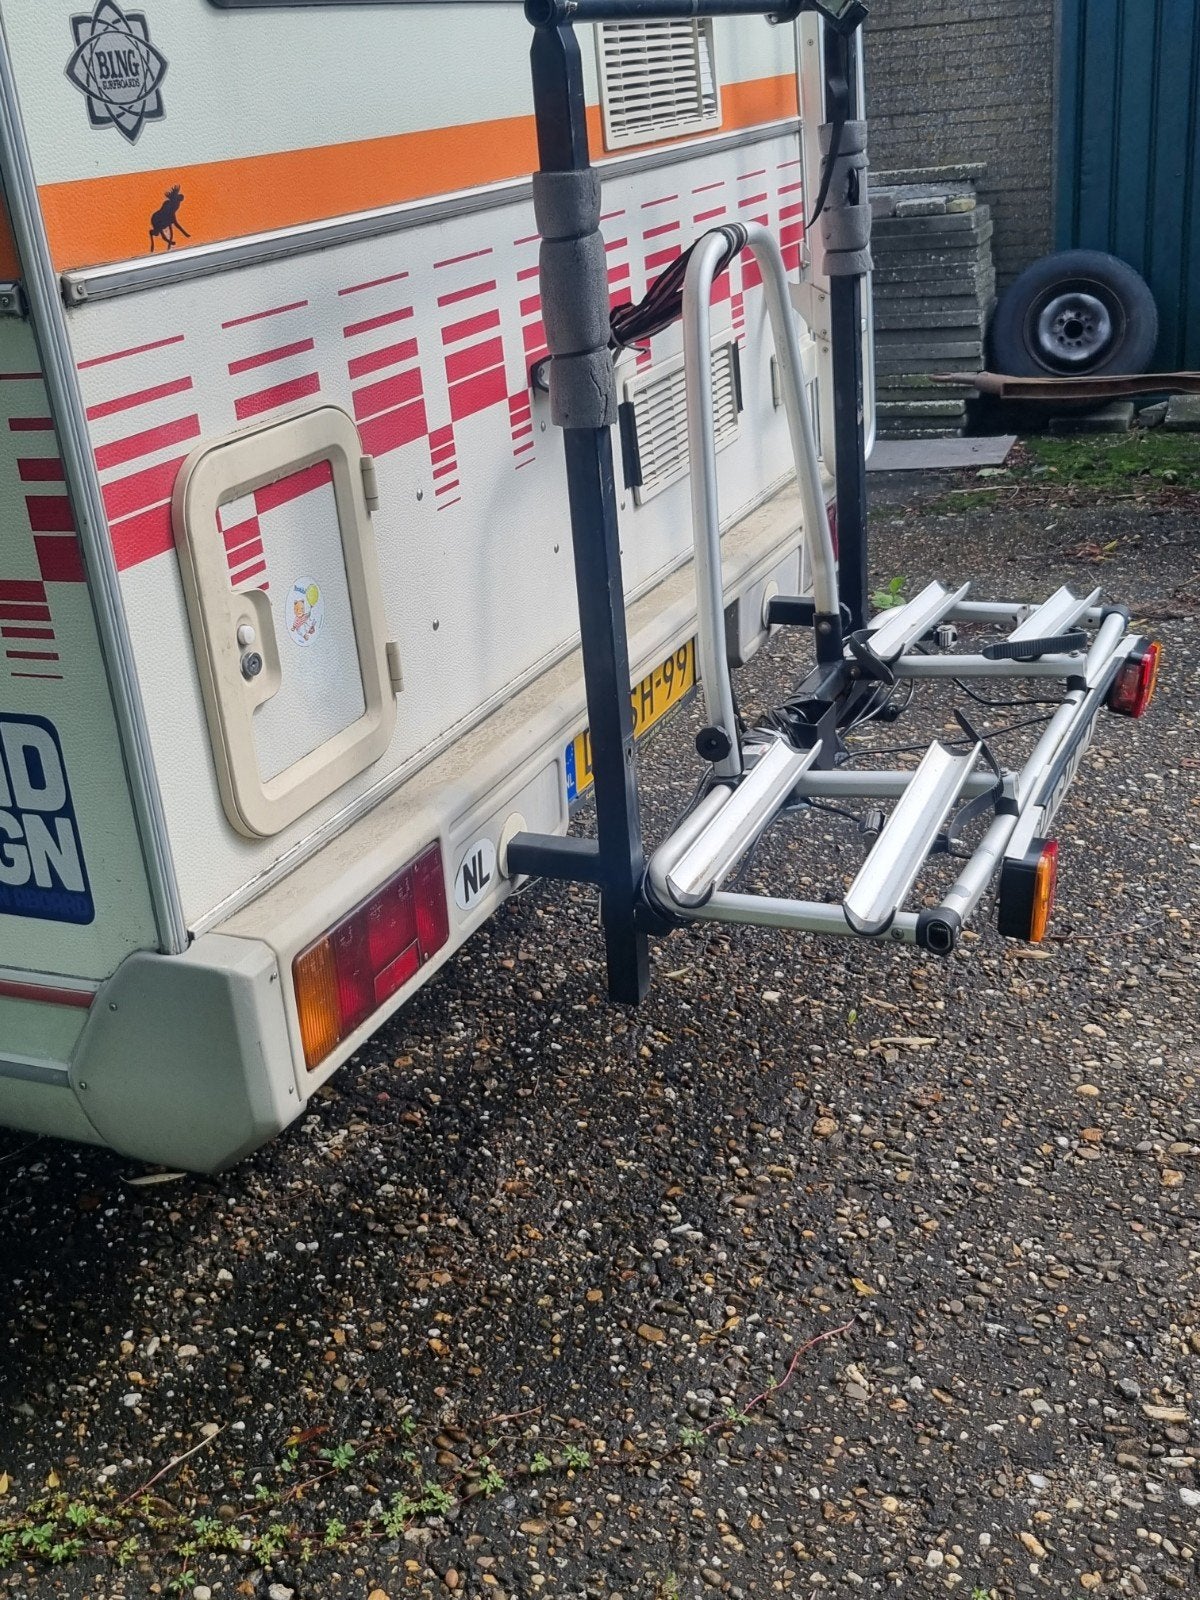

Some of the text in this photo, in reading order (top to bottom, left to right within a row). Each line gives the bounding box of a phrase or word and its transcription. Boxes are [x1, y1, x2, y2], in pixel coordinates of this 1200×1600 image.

[95, 49, 140, 79] BING
[0, 722, 67, 812] D
[462, 849, 490, 904] NL
